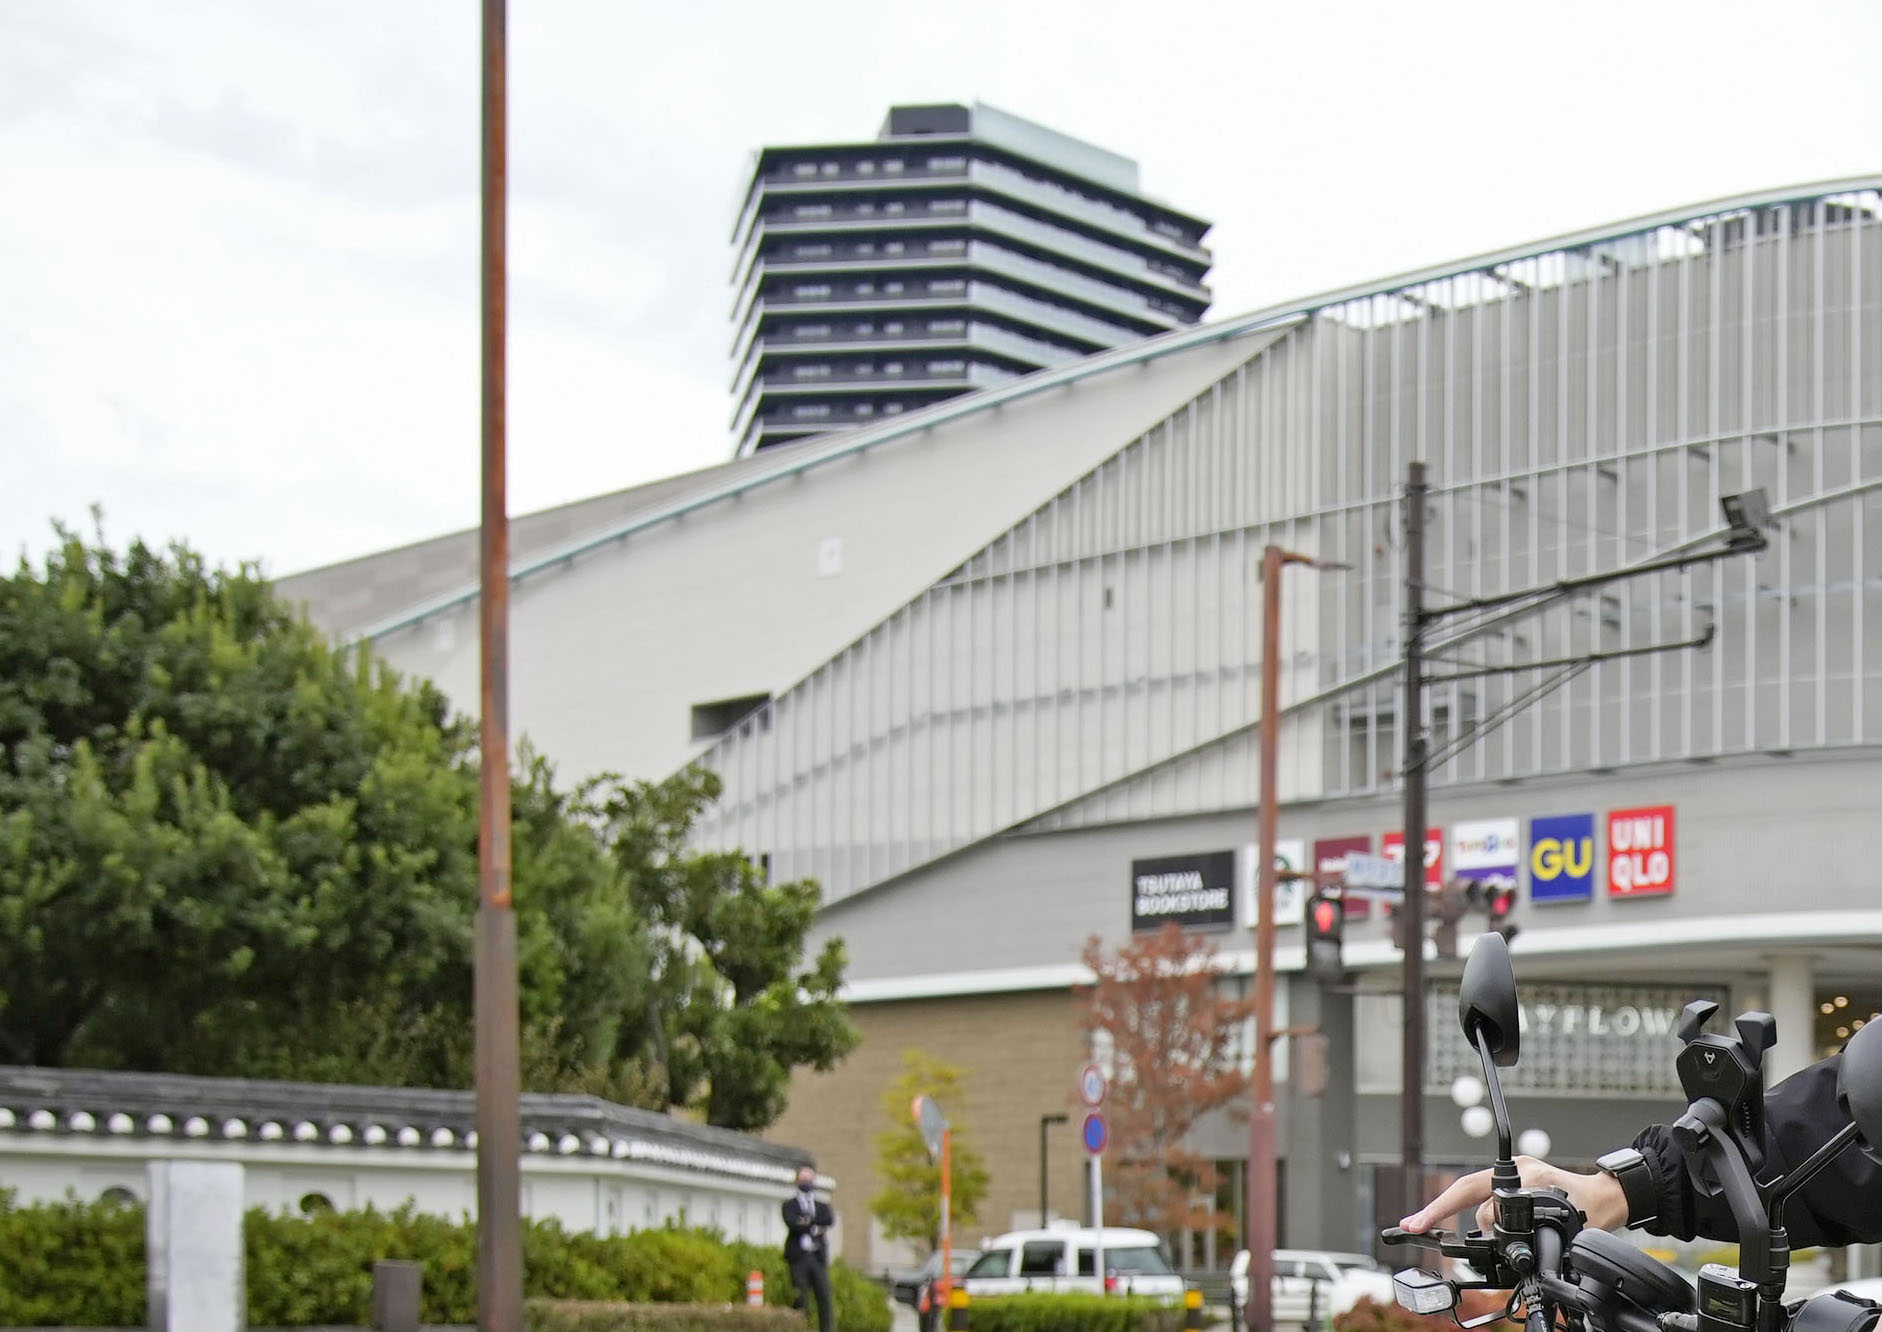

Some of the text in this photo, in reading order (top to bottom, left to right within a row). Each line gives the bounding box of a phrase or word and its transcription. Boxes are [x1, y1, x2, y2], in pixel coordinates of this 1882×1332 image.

[1611, 815, 1665, 851] UNI
[1531, 836, 1594, 881] GU
[1611, 851, 1670, 893] QLO
[1136, 871, 1204, 895] TSUTAYA
[1135, 887, 1230, 917] BOOKSTORE
